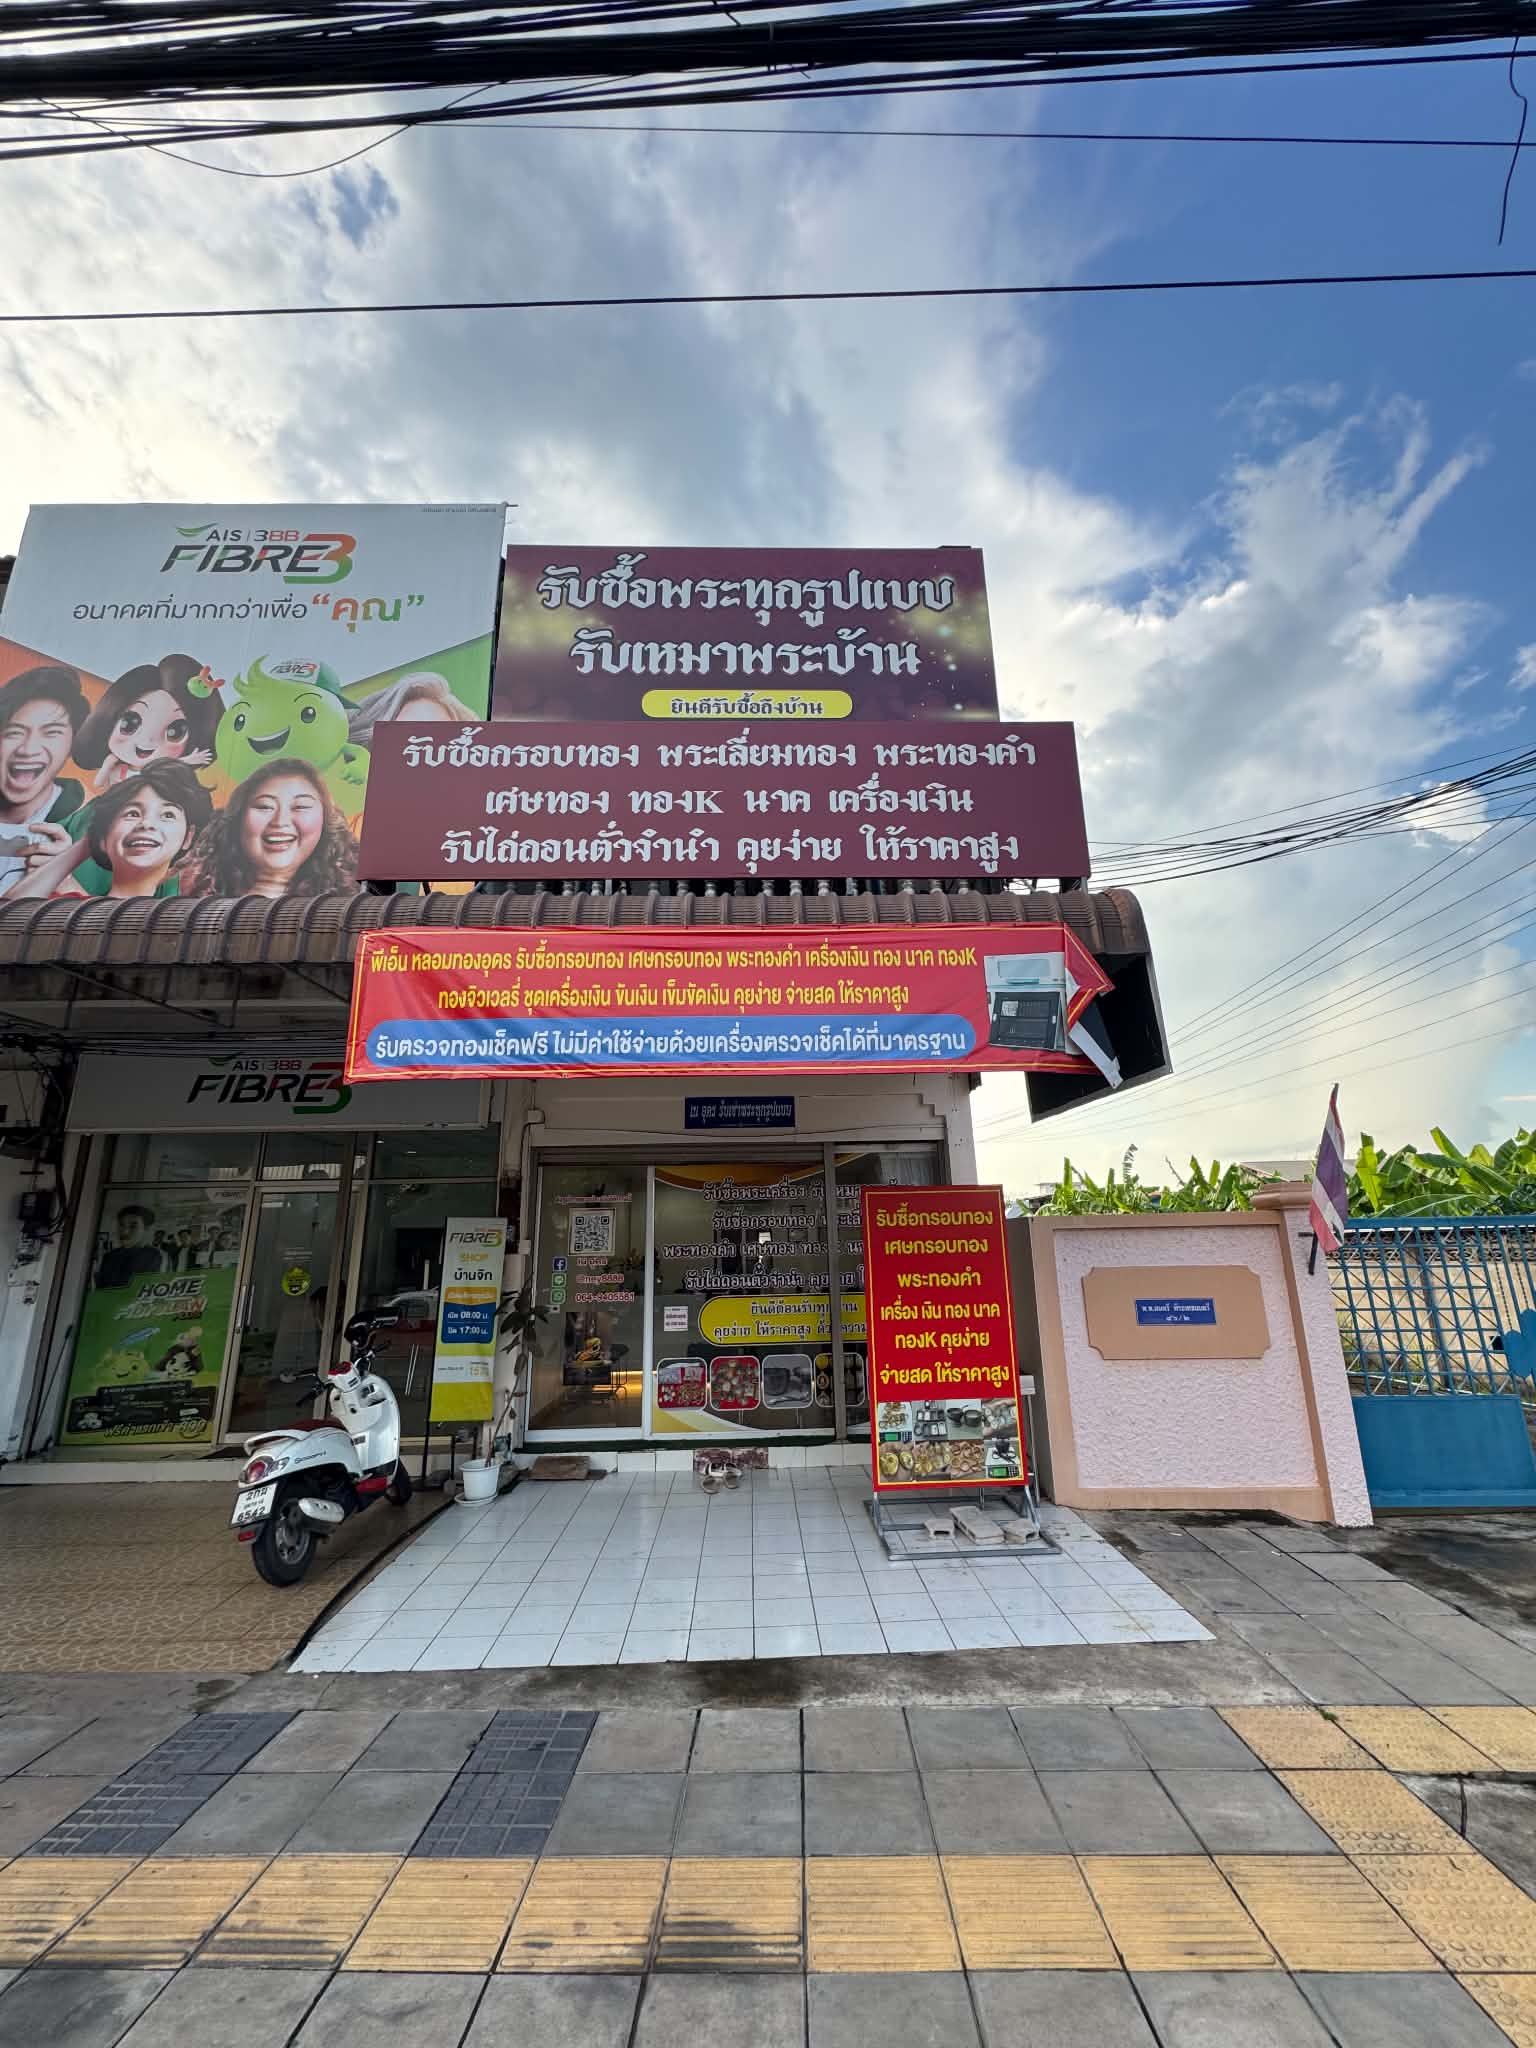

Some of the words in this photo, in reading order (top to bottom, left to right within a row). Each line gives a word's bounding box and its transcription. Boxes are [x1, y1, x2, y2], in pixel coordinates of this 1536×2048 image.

[206, 529, 242, 542] AIS
[254, 529, 300, 543] 3BB
[536, 552, 955, 627] รับซื้อพระทุกรูปแบบ
[72, 593, 307, 621] อนาคตที่มากกว่าเพื่อ
[569, 626, 921, 677] รับเหมาพระบ้าน
[671, 692, 823, 714] ยินดีรับซื้อถึงบ้าน
[403, 727, 639, 767] รับซื้อกรอบทอง
[657, 728, 856, 767] พระเลี่ยมทอง
[873, 734, 1036, 767] พระทองคำ
[486, 787, 609, 814] เศษทอง
[628, 789, 723, 814] ทองK
[744, 788, 810, 813] นาค
[829, 772, 974, 814] เครื่องเงิน
[737, 829, 841, 874] คุยง่าย
[859, 824, 1019, 873] ให้ราคาสูง
[412, 952, 512, 977] หลอมทองอุดร
[516, 939, 623, 969] รับซื้อกรอบทอง
[628, 950, 722, 969] เศษกรอบทอง
[726, 944, 801, 967] พระทองคำ
[805, 938, 869, 967] เครื่องเงิน
[873, 948, 901, 966] ทอง
[905, 948, 934, 967] นาค
[938, 946, 977, 967] ทองK
[524, 975, 611, 1015] ชุดเครื่องเงิน
[615, 983, 657, 1006] ขันเงิน
[662, 979, 729, 1006] เข็มขัดเงิน
[734, 981, 781, 1012] คุยง่าย
[785, 980, 834, 1004] จ่ายสด
[838, 979, 908, 1010] ให้ราคาสูง
[375, 1029, 549, 1058] รับตรวจทองเช็คฟรี
[232, 1060, 259, 1070] AIS
[268, 1059, 301, 1070] 3BB
[876, 1202, 993, 1227] รับซื้อกรอบทอง
[885, 1239, 988, 1255] เศษกรอบทอง
[898, 1266, 981, 1287] พระทองคำ
[945, 1305, 969, 1319] ทอง
[974, 1303, 1000, 1318] นาค
[895, 1332, 936, 1349] ทองK
[941, 1328, 989, 1354] คุยง่าย
[880, 1364, 932, 1385] จ่ายสด
[935, 1362, 1009, 1388] ให้ราคาสูง
